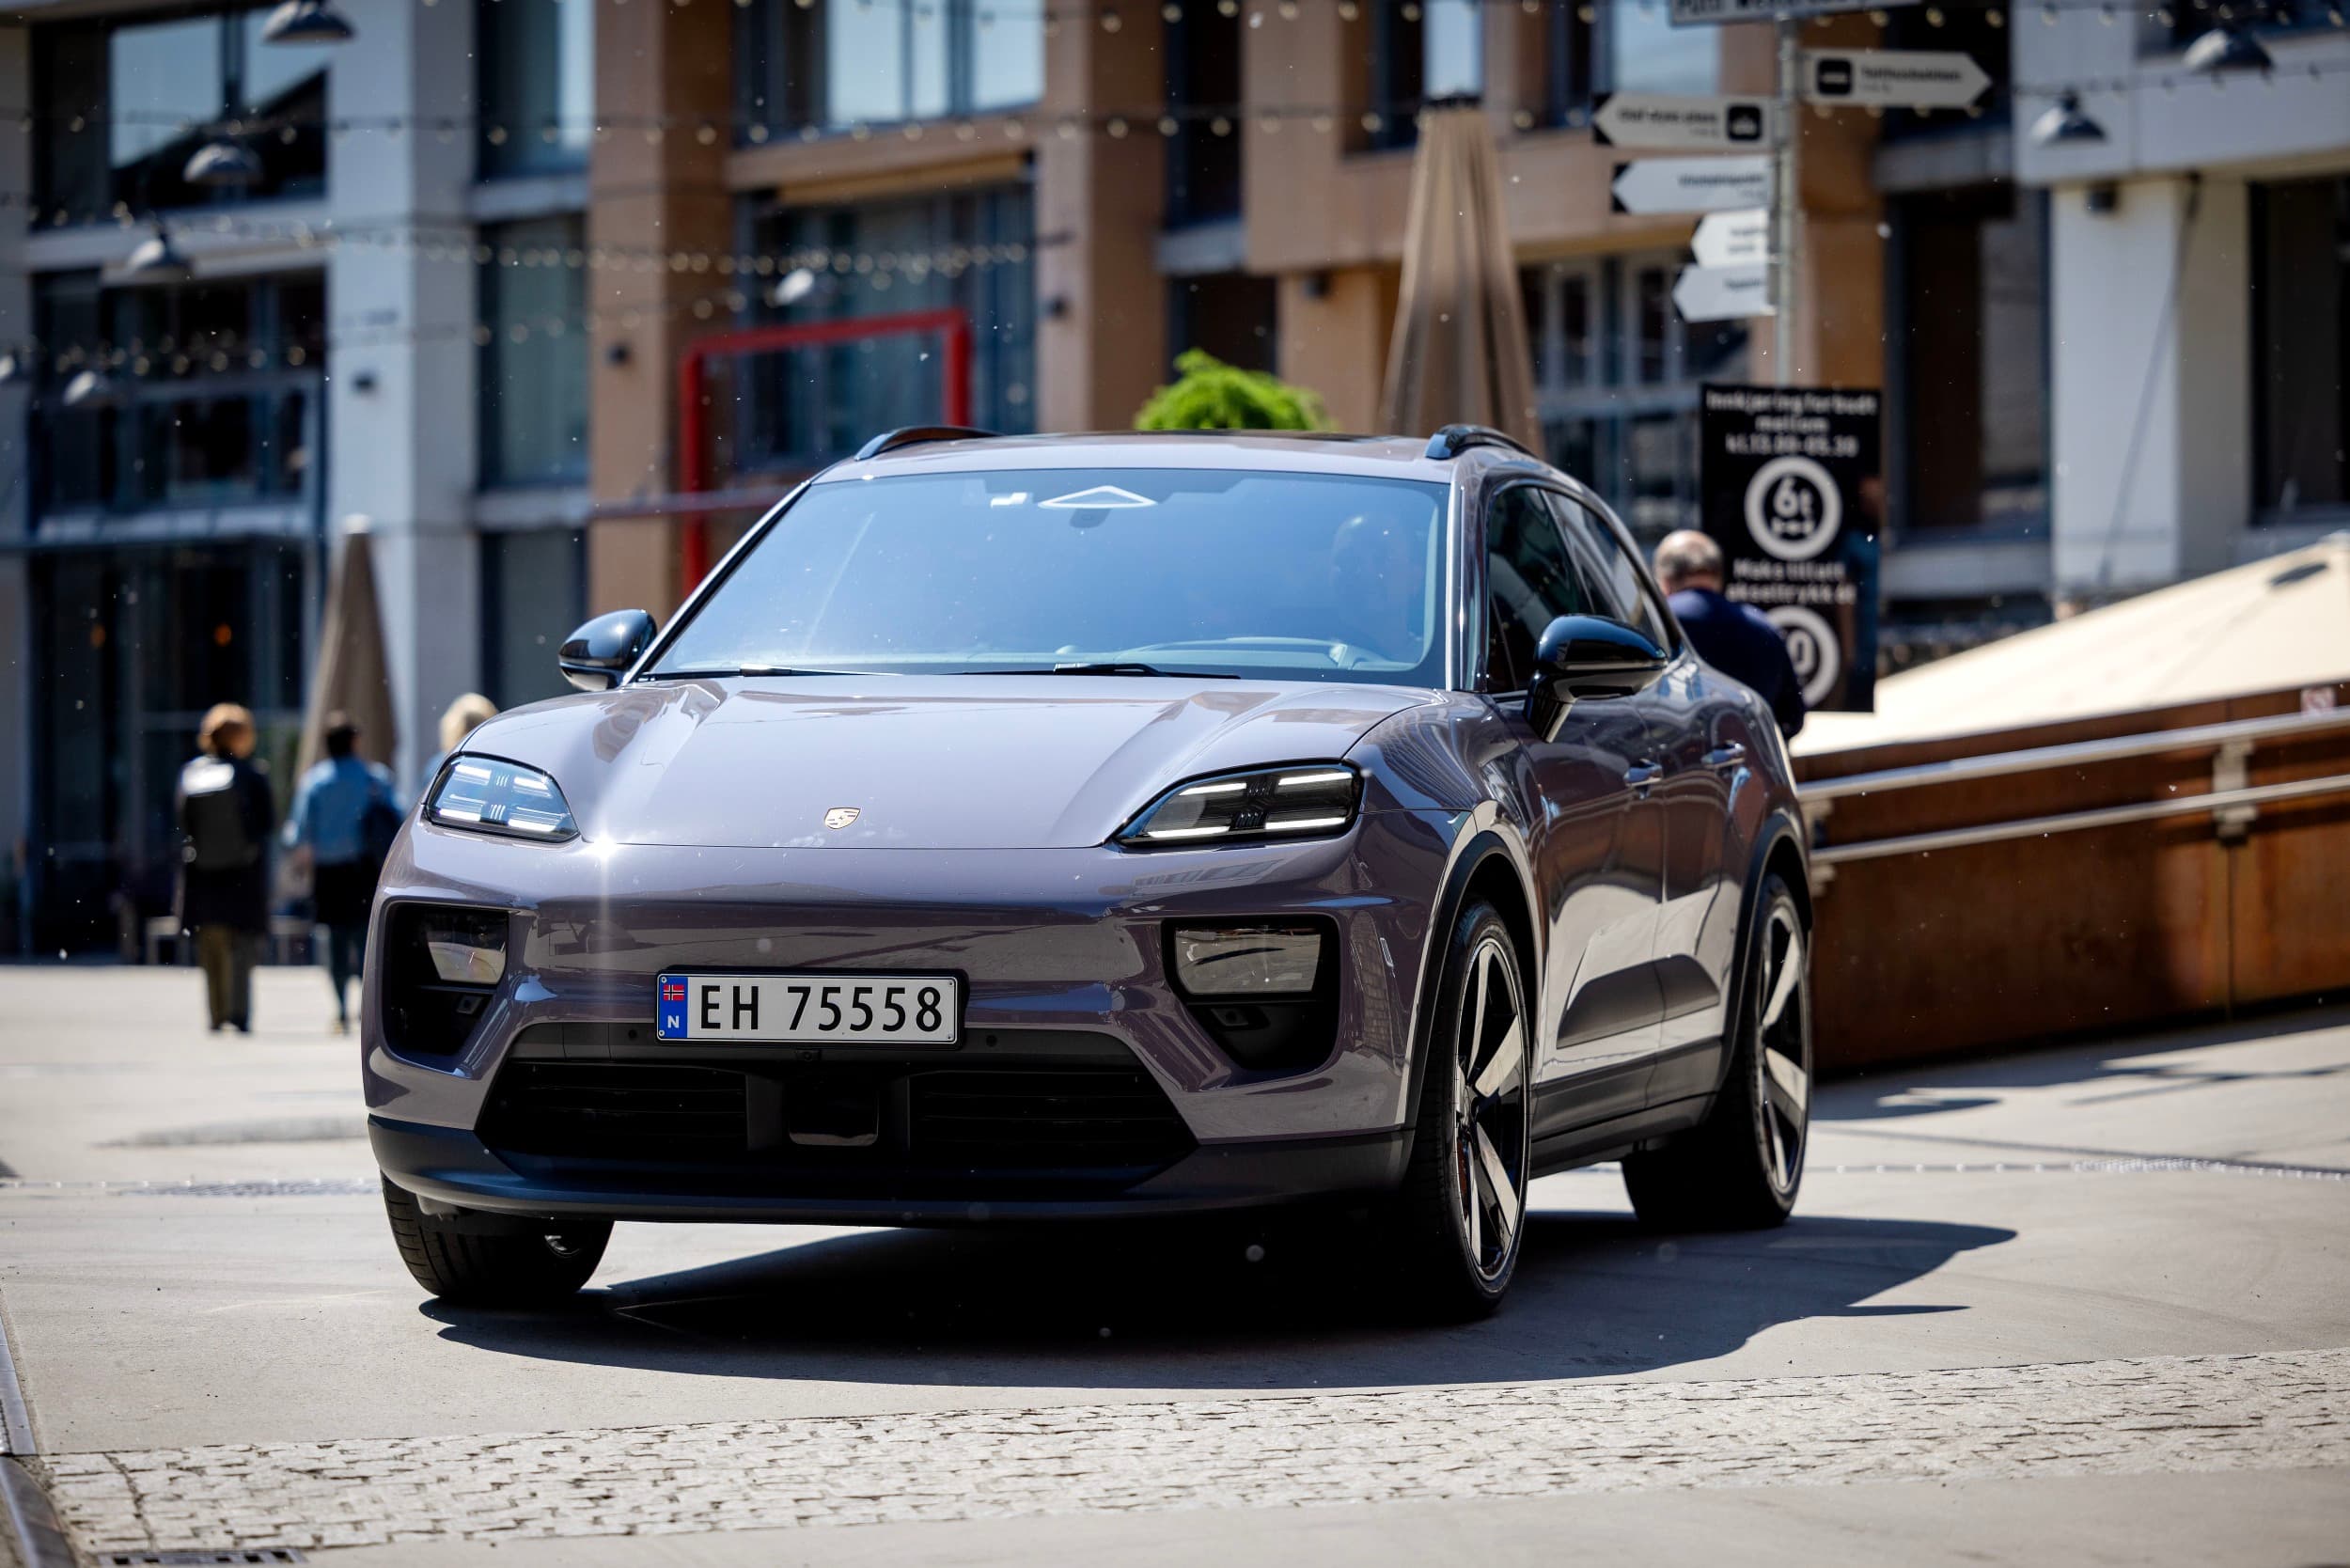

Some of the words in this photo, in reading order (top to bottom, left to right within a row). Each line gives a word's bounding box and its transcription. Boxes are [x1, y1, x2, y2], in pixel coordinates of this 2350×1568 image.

[1755, 415, 1829, 433] mellom
[699, 984, 760, 1031] EH
[787, 986, 942, 1032] 75558
[666, 1014, 680, 1029] N
